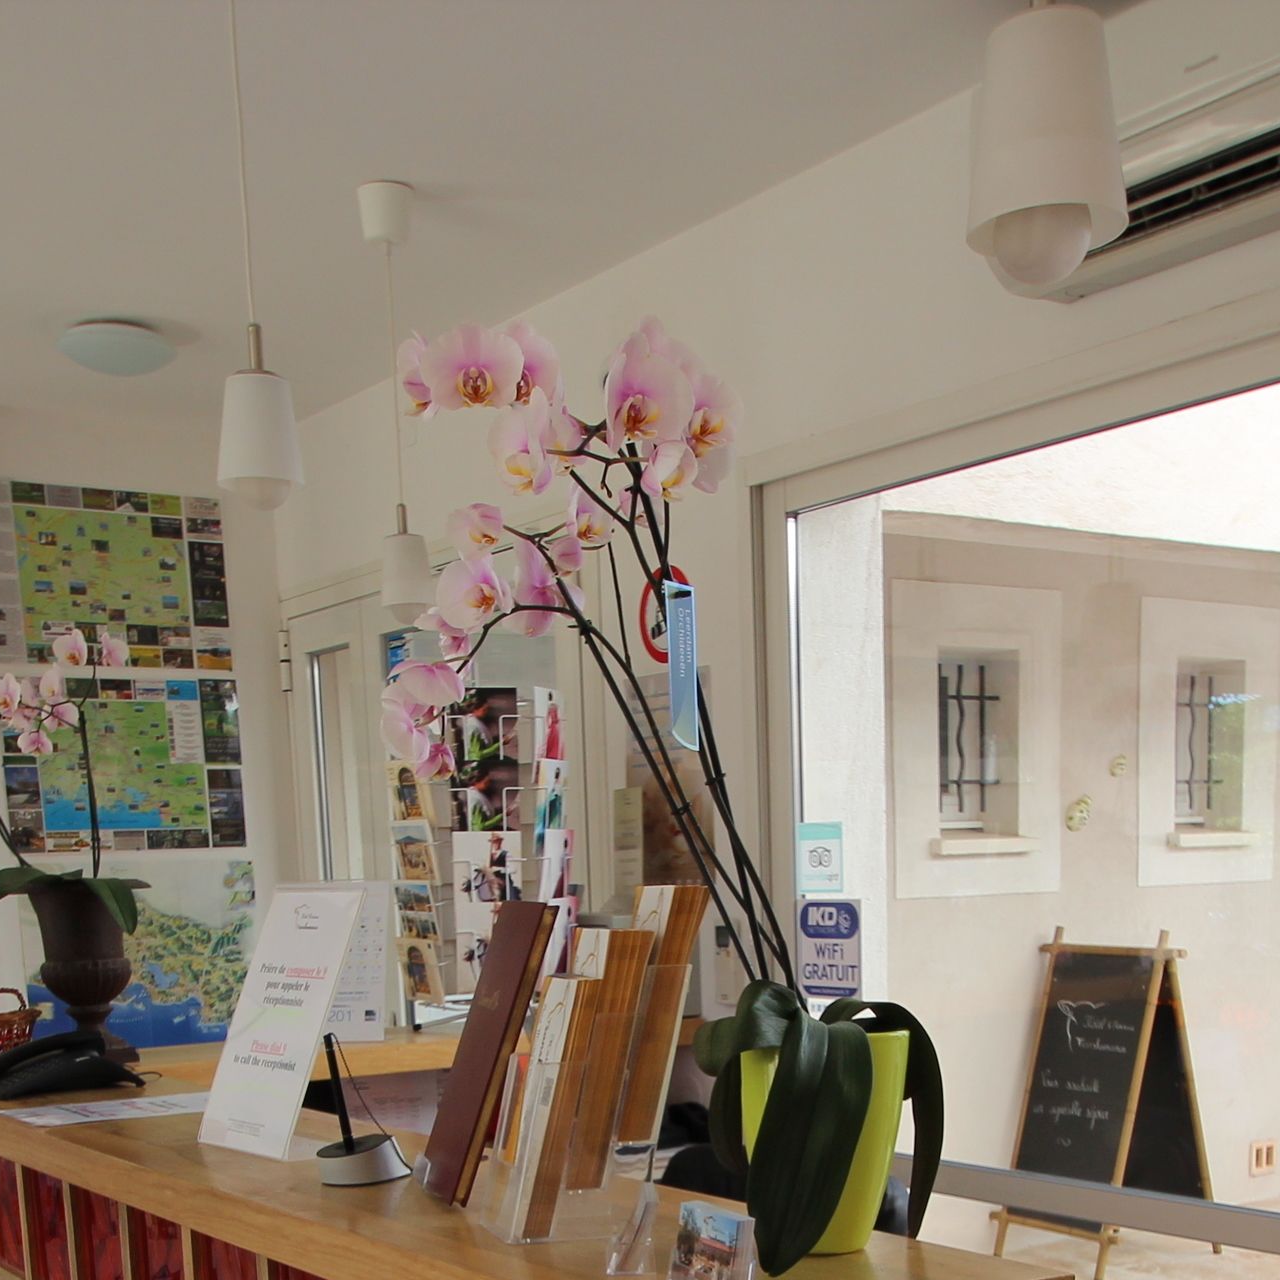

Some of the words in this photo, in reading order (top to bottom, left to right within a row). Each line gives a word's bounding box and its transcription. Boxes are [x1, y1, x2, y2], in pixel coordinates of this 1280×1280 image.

[807, 906, 838, 926] IKD
[814, 943, 845, 960] WiFi
[278, 965, 287, 975] de
[802, 963, 859, 982] GRATUIT
[265, 981, 281, 991] pour
[281, 980, 304, 993] appeler
[303, 981, 311, 992] le
[233, 1055, 240, 1063] to
[240, 1055, 252, 1065] call
[251, 1056, 261, 1066] the
